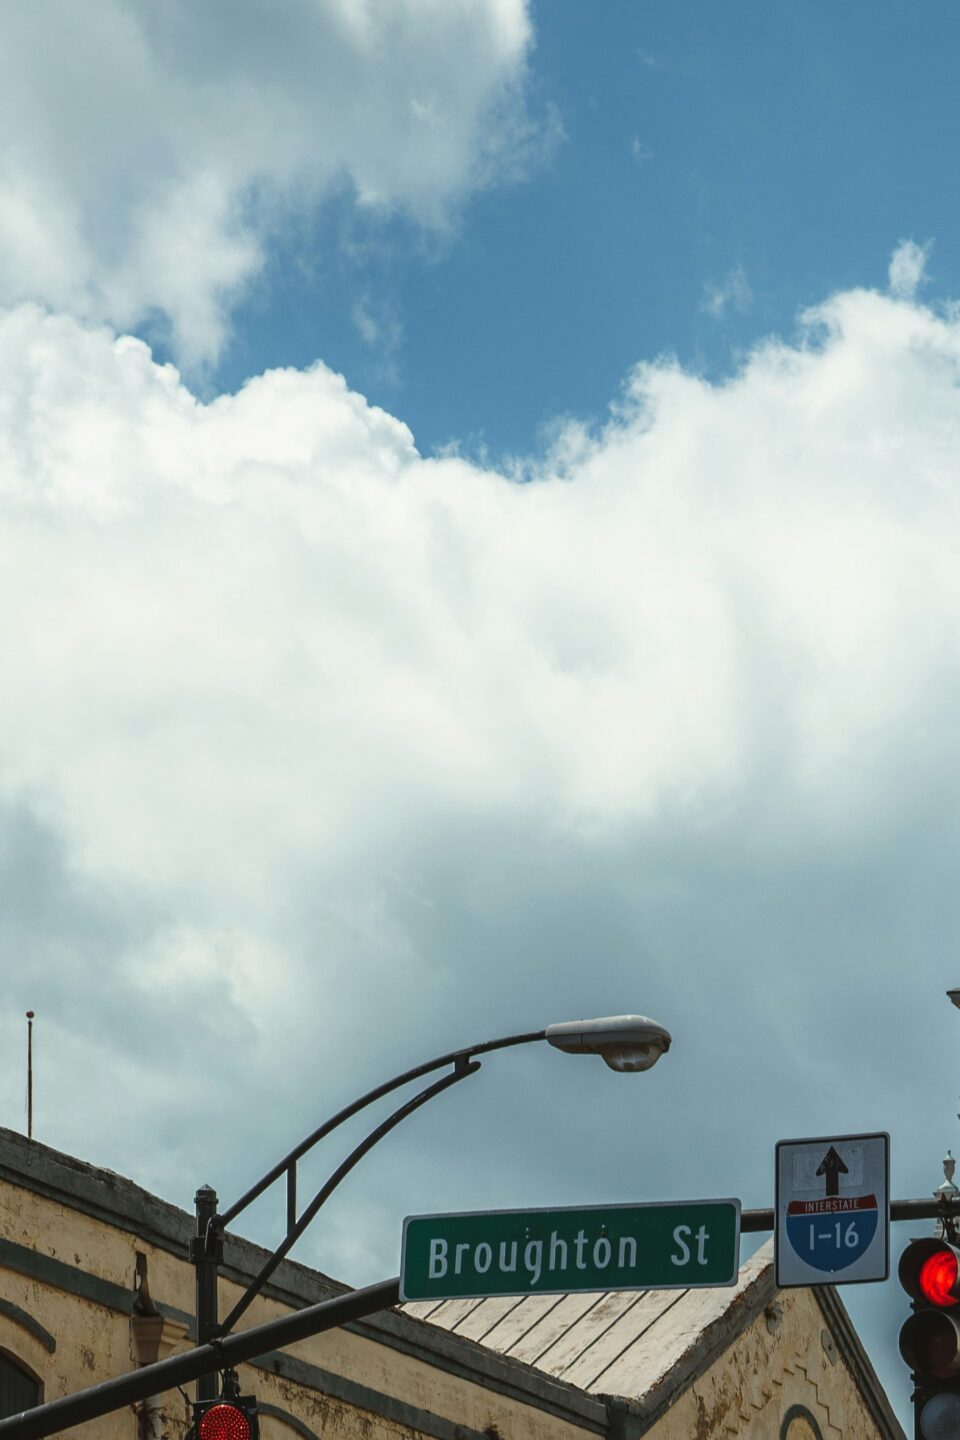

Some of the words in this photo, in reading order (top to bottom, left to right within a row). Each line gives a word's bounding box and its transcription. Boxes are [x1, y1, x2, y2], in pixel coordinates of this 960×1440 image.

[805, 1200, 860, 1213] INTERSTATE
[809, 1221, 859, 1251] I-16
[428, 1230, 637, 1285] Broughton
[670, 1224, 710, 1267] St
